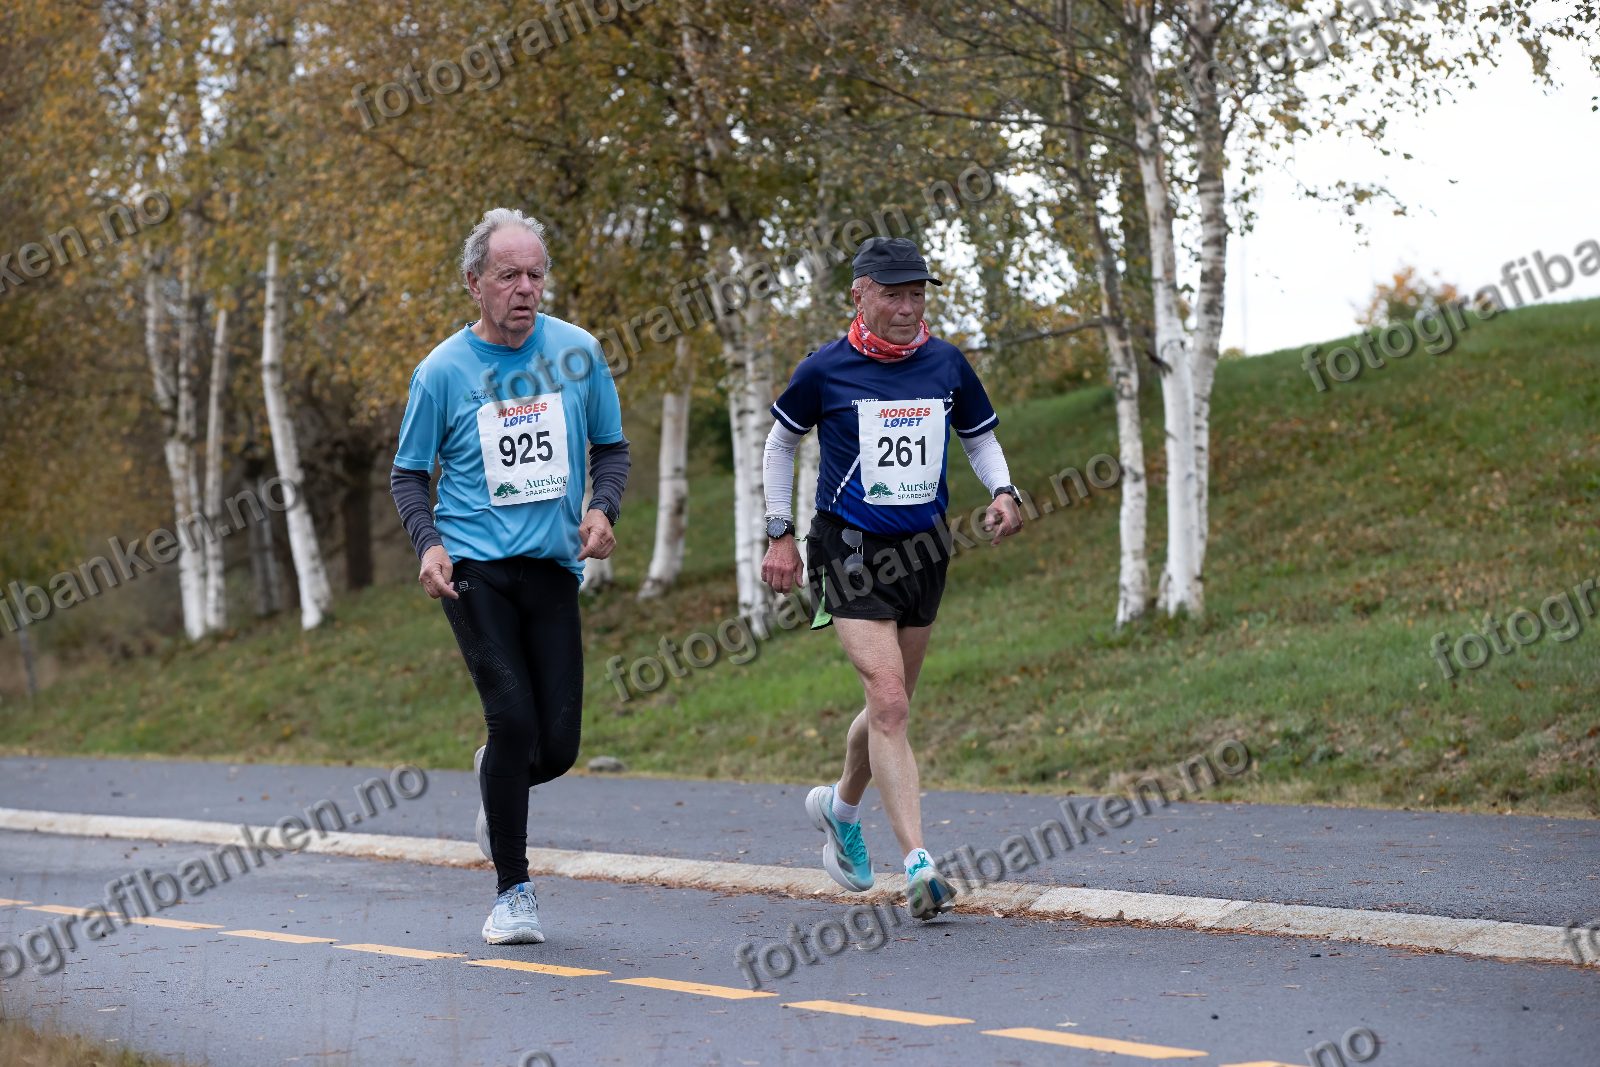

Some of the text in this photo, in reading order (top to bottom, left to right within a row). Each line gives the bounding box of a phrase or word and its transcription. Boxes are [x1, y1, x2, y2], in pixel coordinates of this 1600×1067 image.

[498, 402, 548, 418] NORGES
[879, 407, 931, 419] NORGES
[503, 413, 541, 428] LØPET
[883, 417, 924, 429] LØPET
[498, 431, 553, 467] 925
[877, 436, 926, 468] 261
[523, 474, 567, 490] Aurskog
[897, 480, 938, 493] Aurskog
